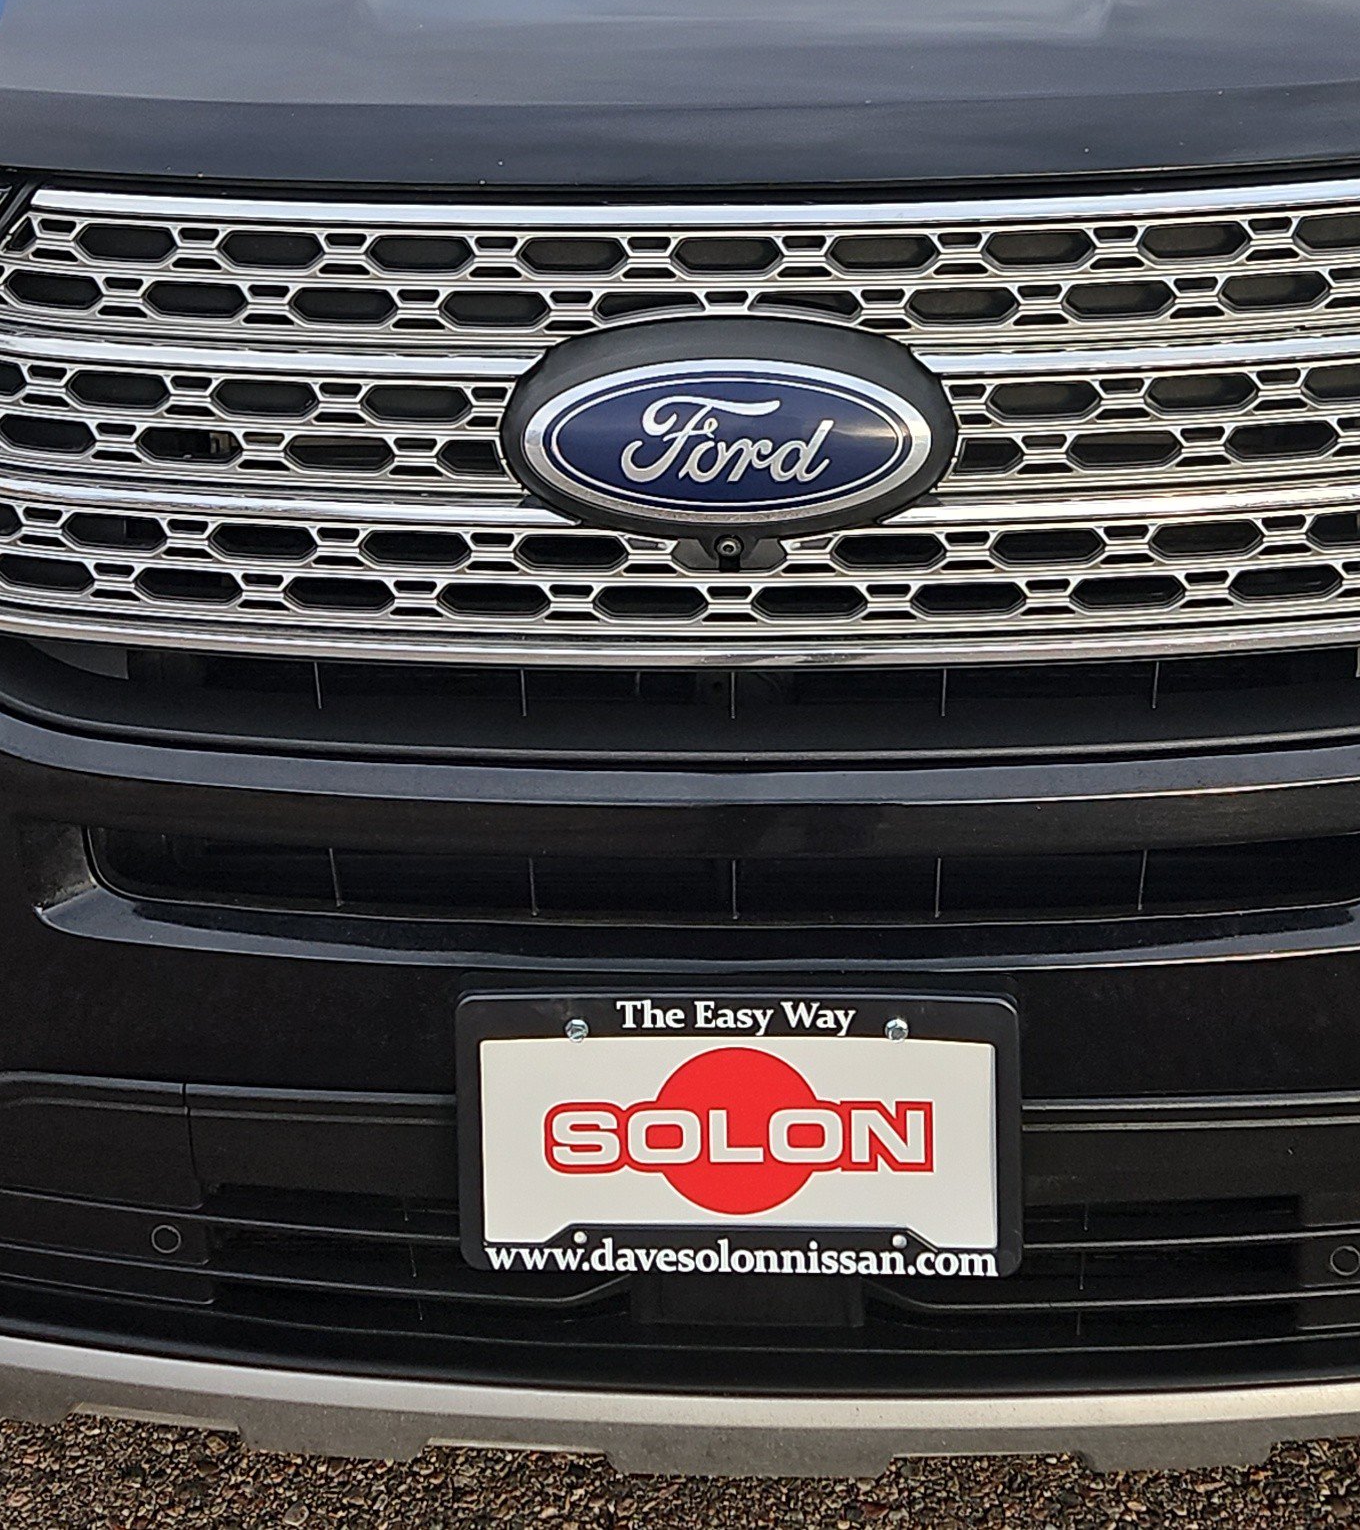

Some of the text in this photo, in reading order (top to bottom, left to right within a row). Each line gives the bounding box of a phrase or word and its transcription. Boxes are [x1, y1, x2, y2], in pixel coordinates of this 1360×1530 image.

[621, 395, 834, 484] Ford
[616, 1000, 856, 1037] The Easy Way
[548, 1105, 931, 1168] SOLON
[484, 1238, 999, 1278] www.davesolonnissan.com
